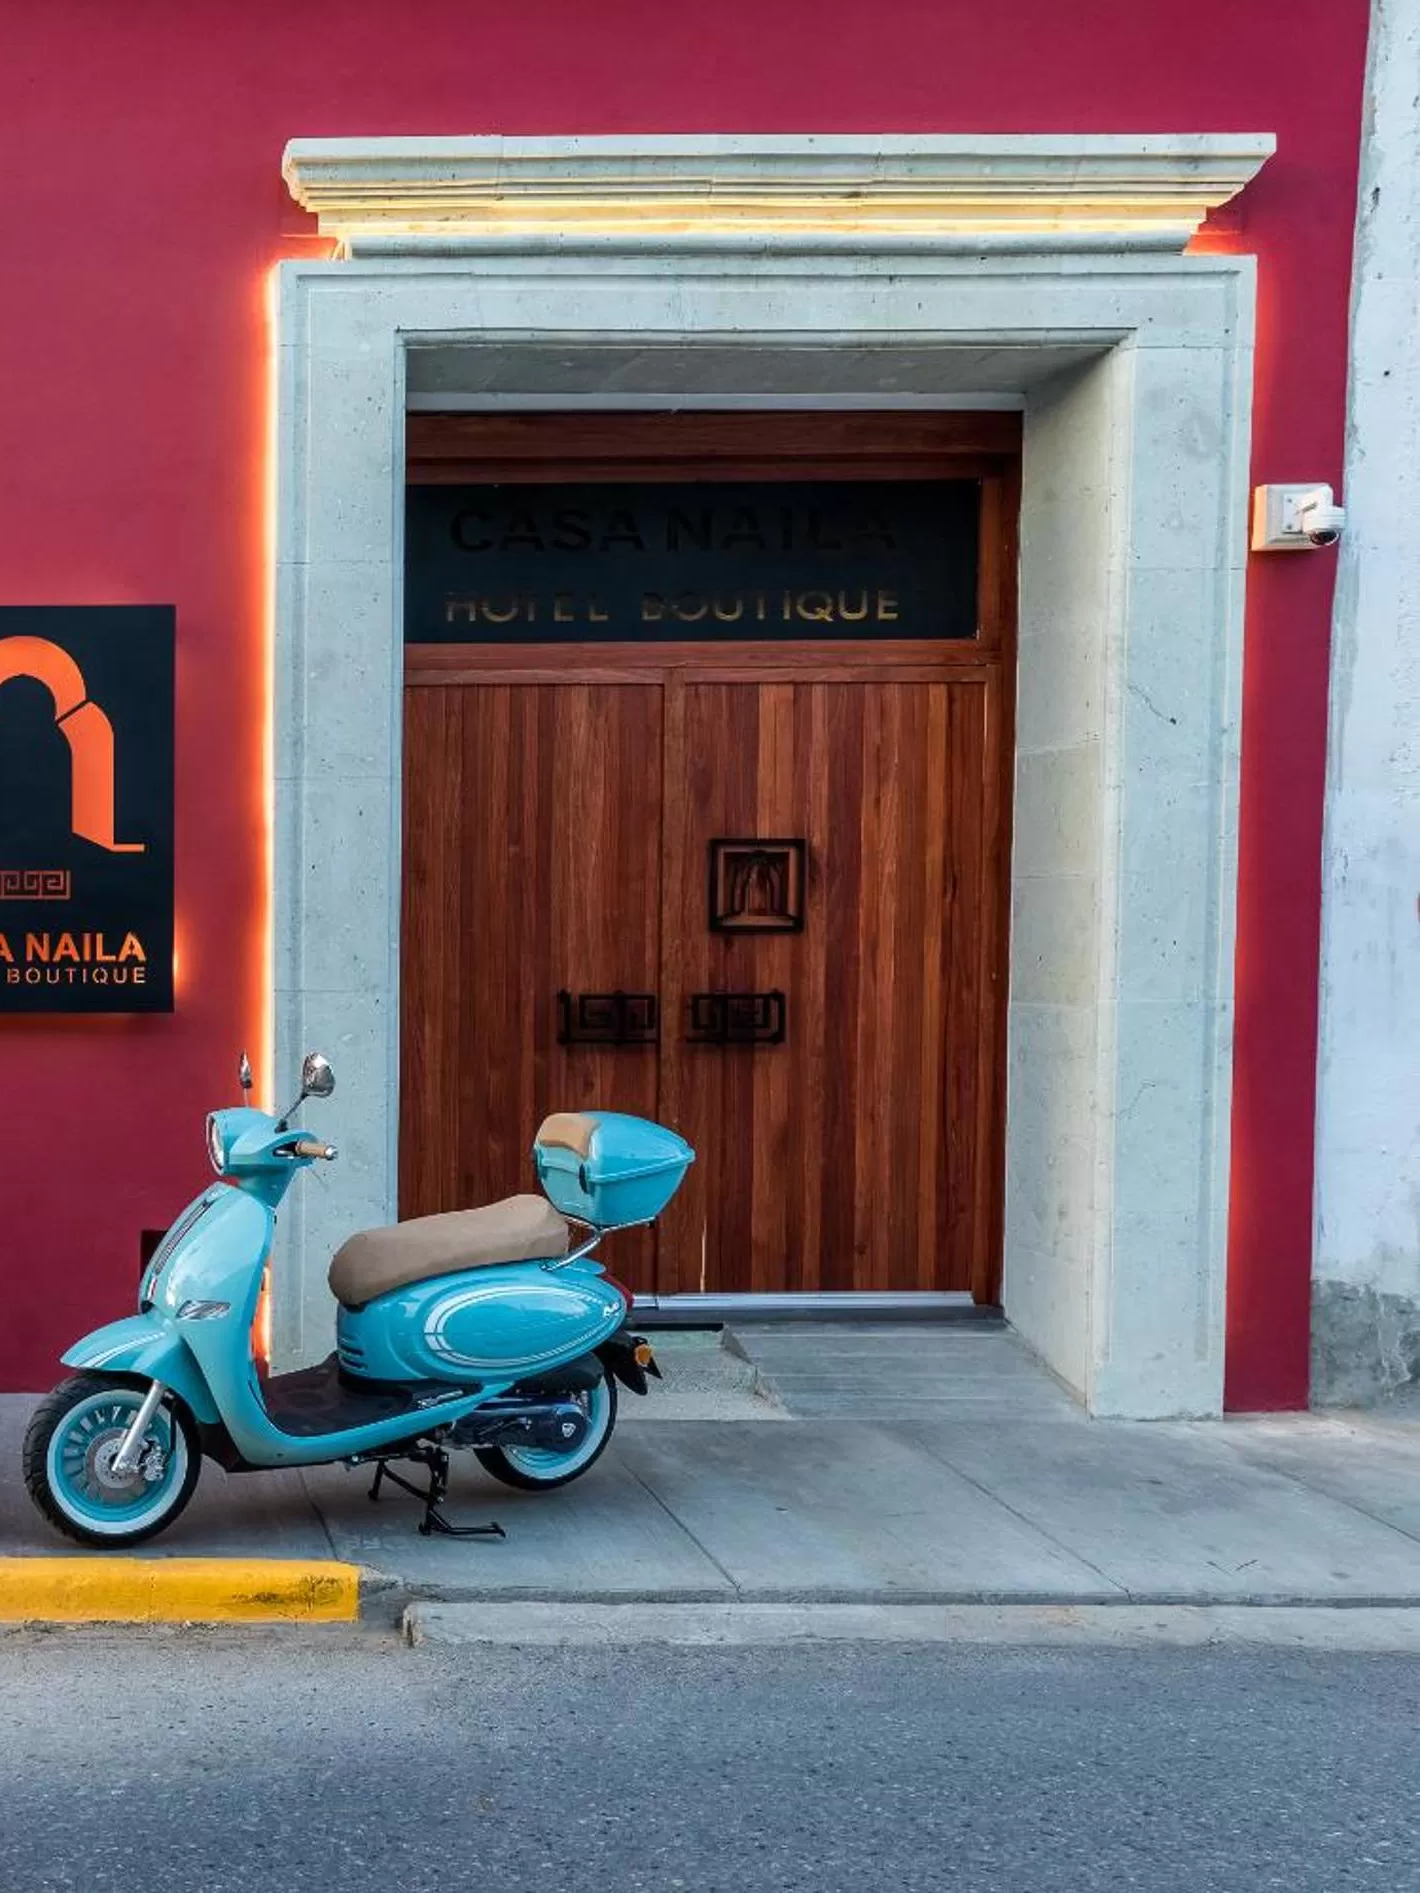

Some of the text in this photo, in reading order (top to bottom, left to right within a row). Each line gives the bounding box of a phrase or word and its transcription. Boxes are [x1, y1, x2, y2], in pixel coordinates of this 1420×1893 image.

[449, 506, 898, 552] CASA NAILA
[444, 589, 899, 622] HOTEL BOUTIQUE
[25, 932, 147, 962] NAILA
[7, 967, 146, 985] BOUTIQUE
